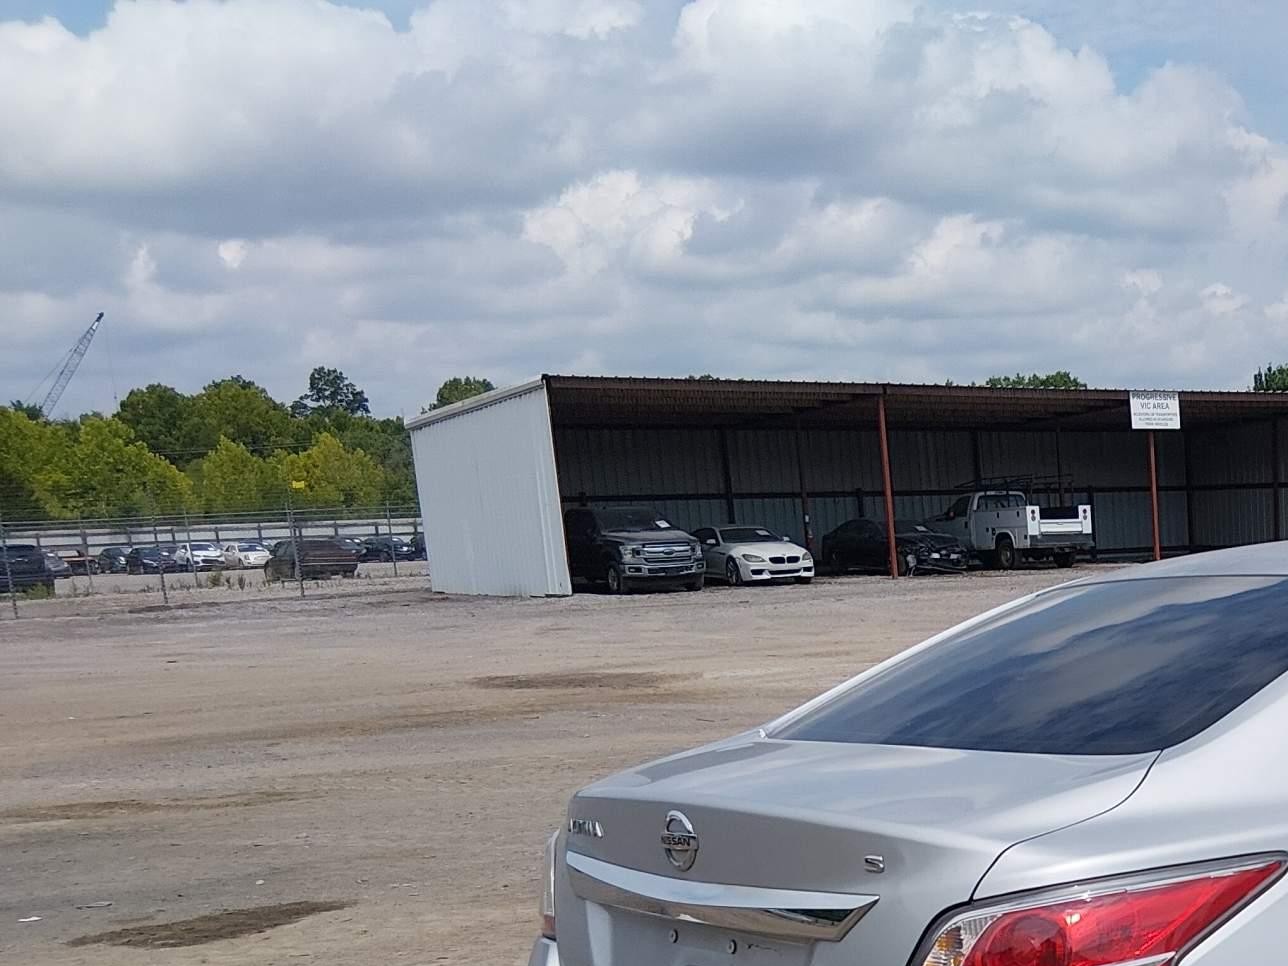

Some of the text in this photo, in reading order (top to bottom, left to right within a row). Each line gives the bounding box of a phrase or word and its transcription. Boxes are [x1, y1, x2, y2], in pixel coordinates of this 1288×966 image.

[1131, 392, 1177, 401] PROGRESSIVE
[1140, 402, 1170, 410] VIC AREA
[864, 855, 885, 873] S
